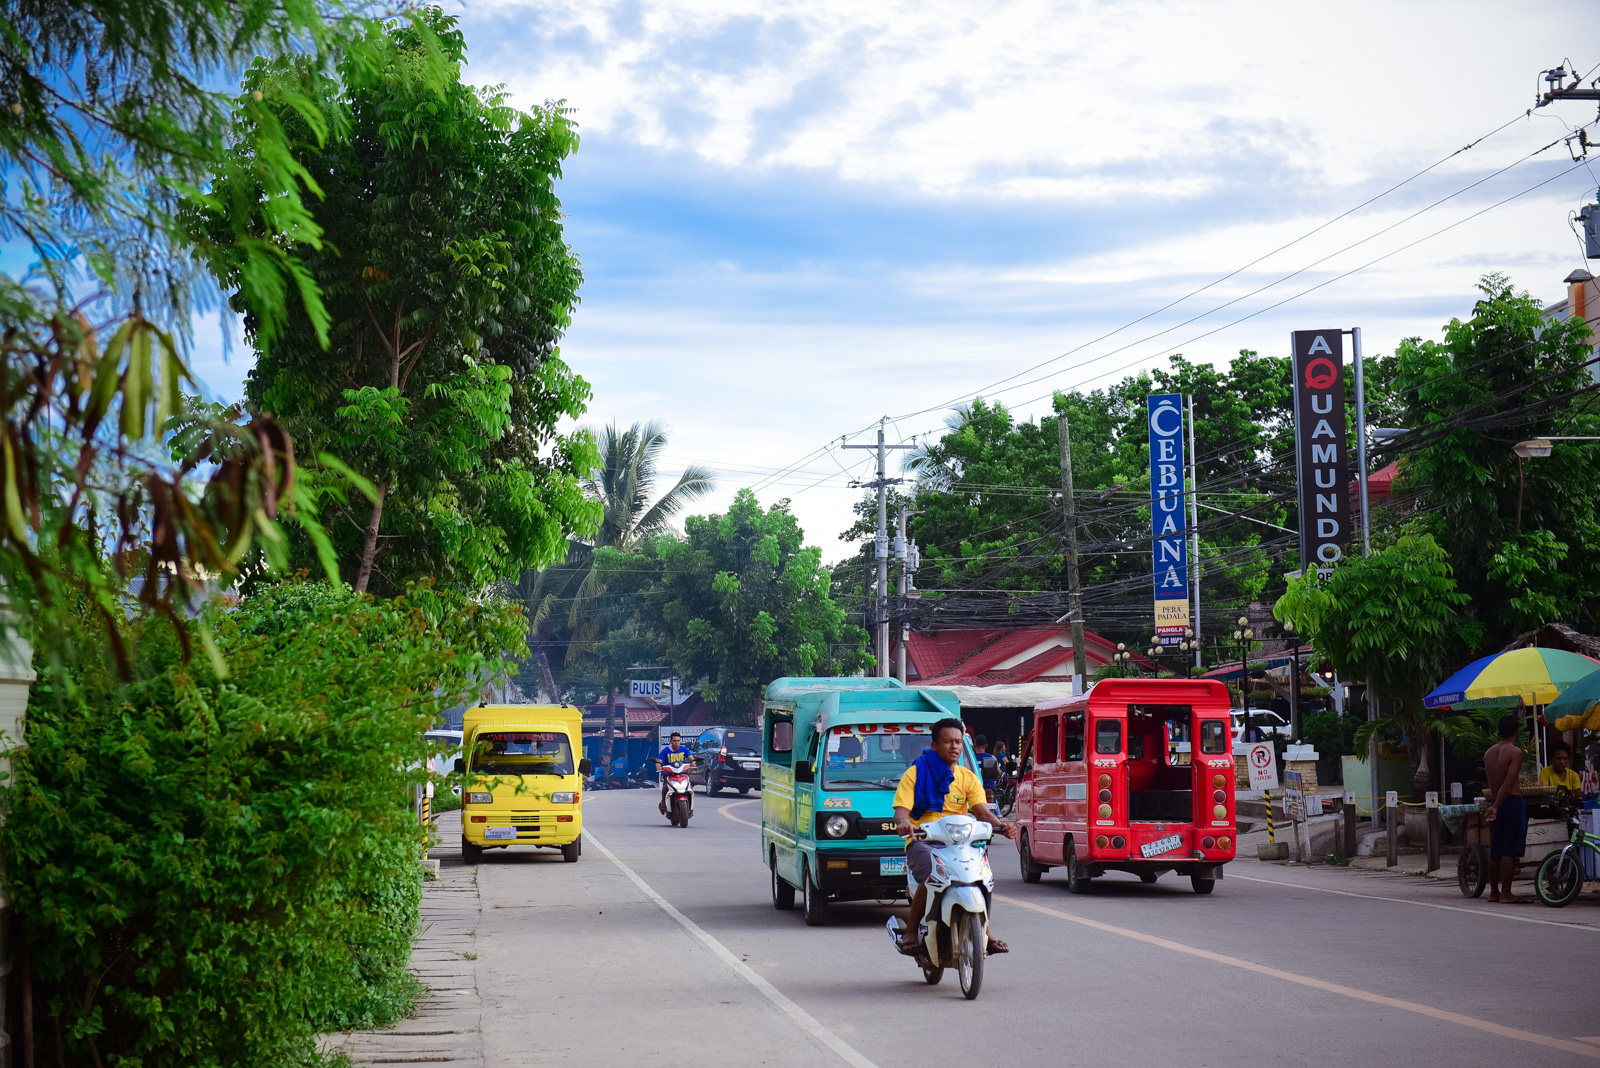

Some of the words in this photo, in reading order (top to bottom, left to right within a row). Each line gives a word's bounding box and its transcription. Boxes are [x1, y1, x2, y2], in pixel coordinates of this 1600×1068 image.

[1305, 335, 1341, 562] AQUAMUNDO
[632, 682, 661, 695] PULIS
[833, 723, 933, 735] RUSC
